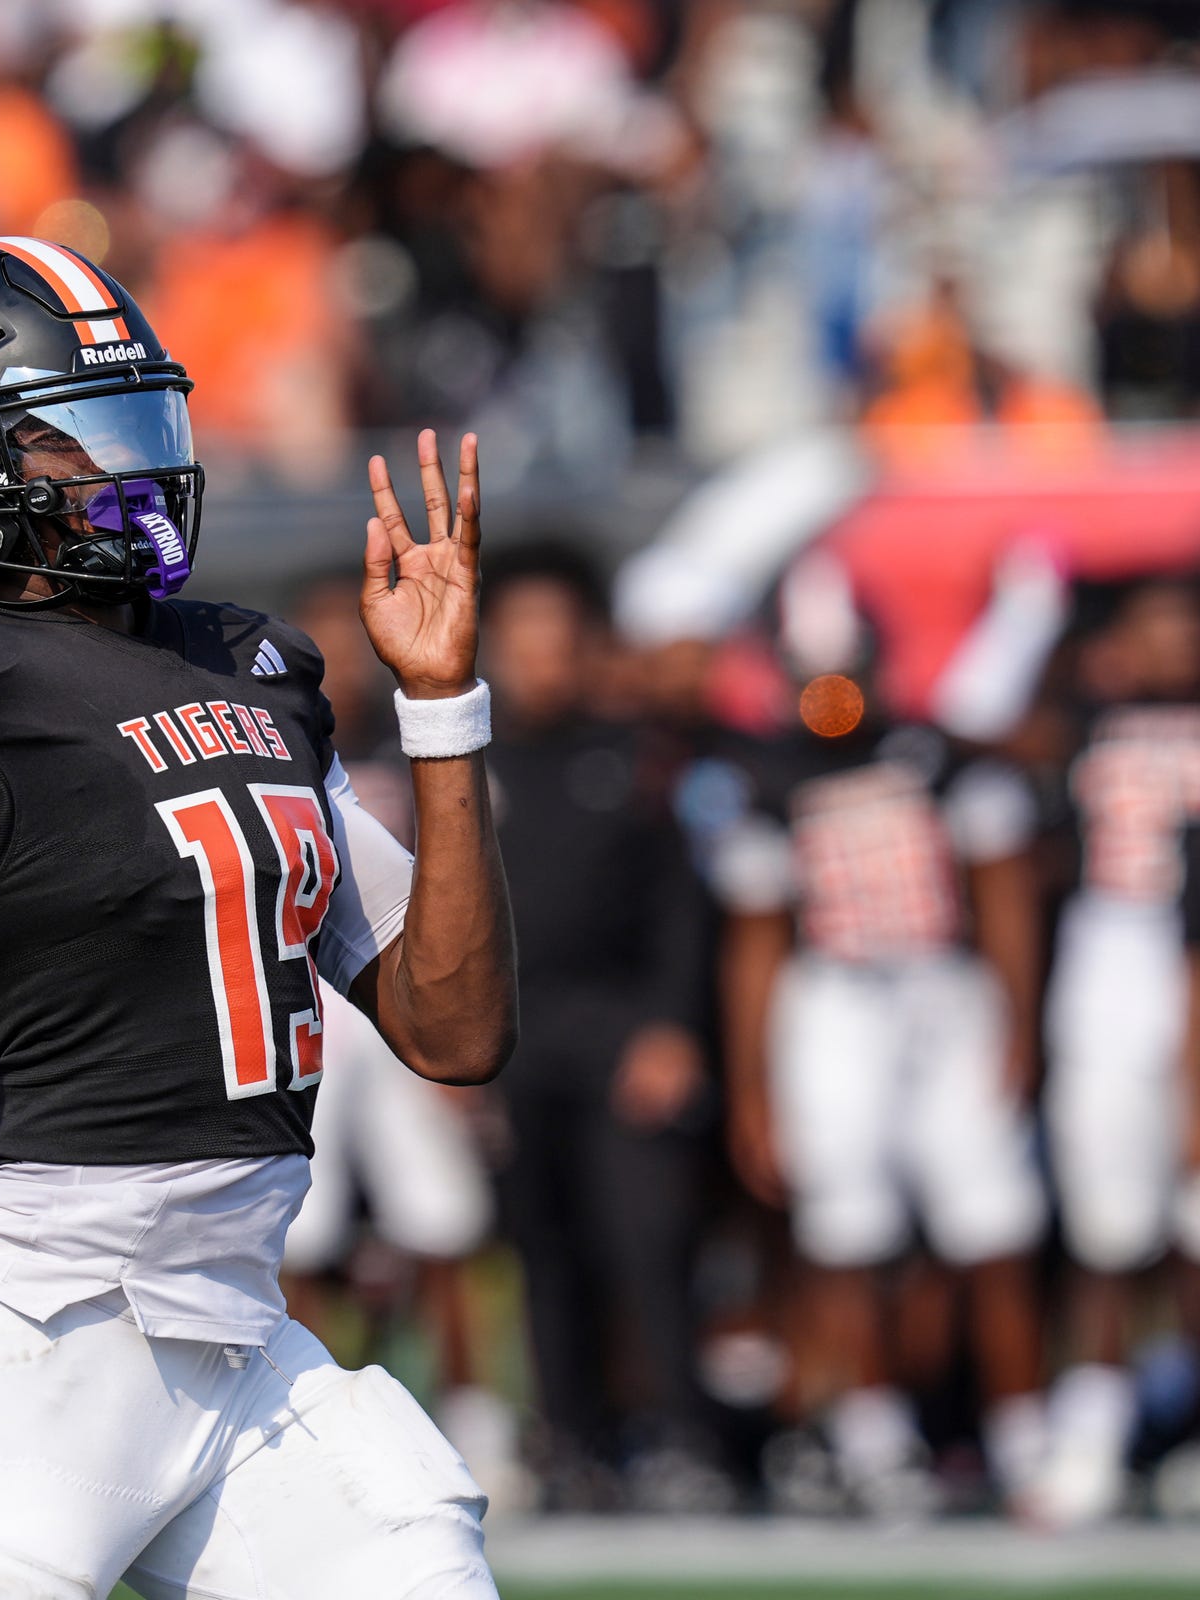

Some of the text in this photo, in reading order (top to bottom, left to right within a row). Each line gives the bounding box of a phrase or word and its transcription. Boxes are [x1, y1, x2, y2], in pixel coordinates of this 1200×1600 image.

[80, 342, 147, 365] Riddell
[136, 512, 184, 566] NXTRND
[116, 700, 292, 773] TIGERS
[154, 783, 340, 1100] 19
